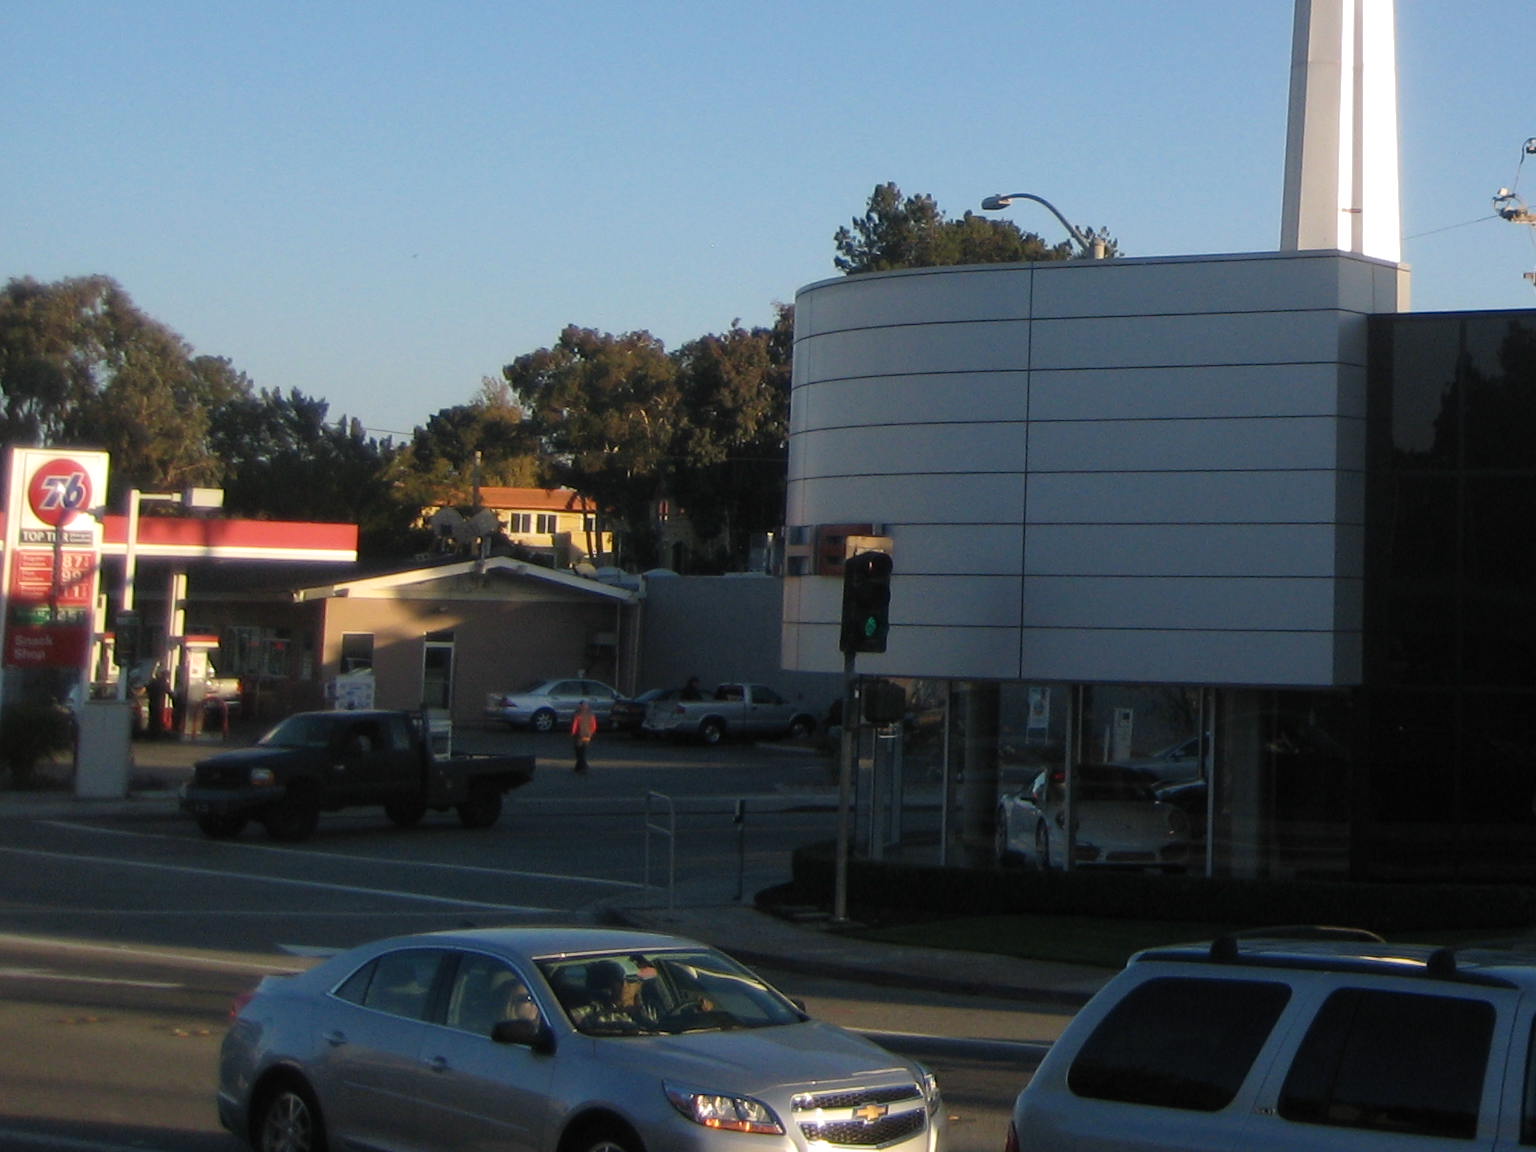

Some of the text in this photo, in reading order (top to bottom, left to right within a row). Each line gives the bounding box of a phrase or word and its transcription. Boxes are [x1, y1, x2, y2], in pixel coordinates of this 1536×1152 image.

[39, 472, 87, 510] 76
[22, 530, 45, 543] TOP
[46, 530, 71, 543] TIR
